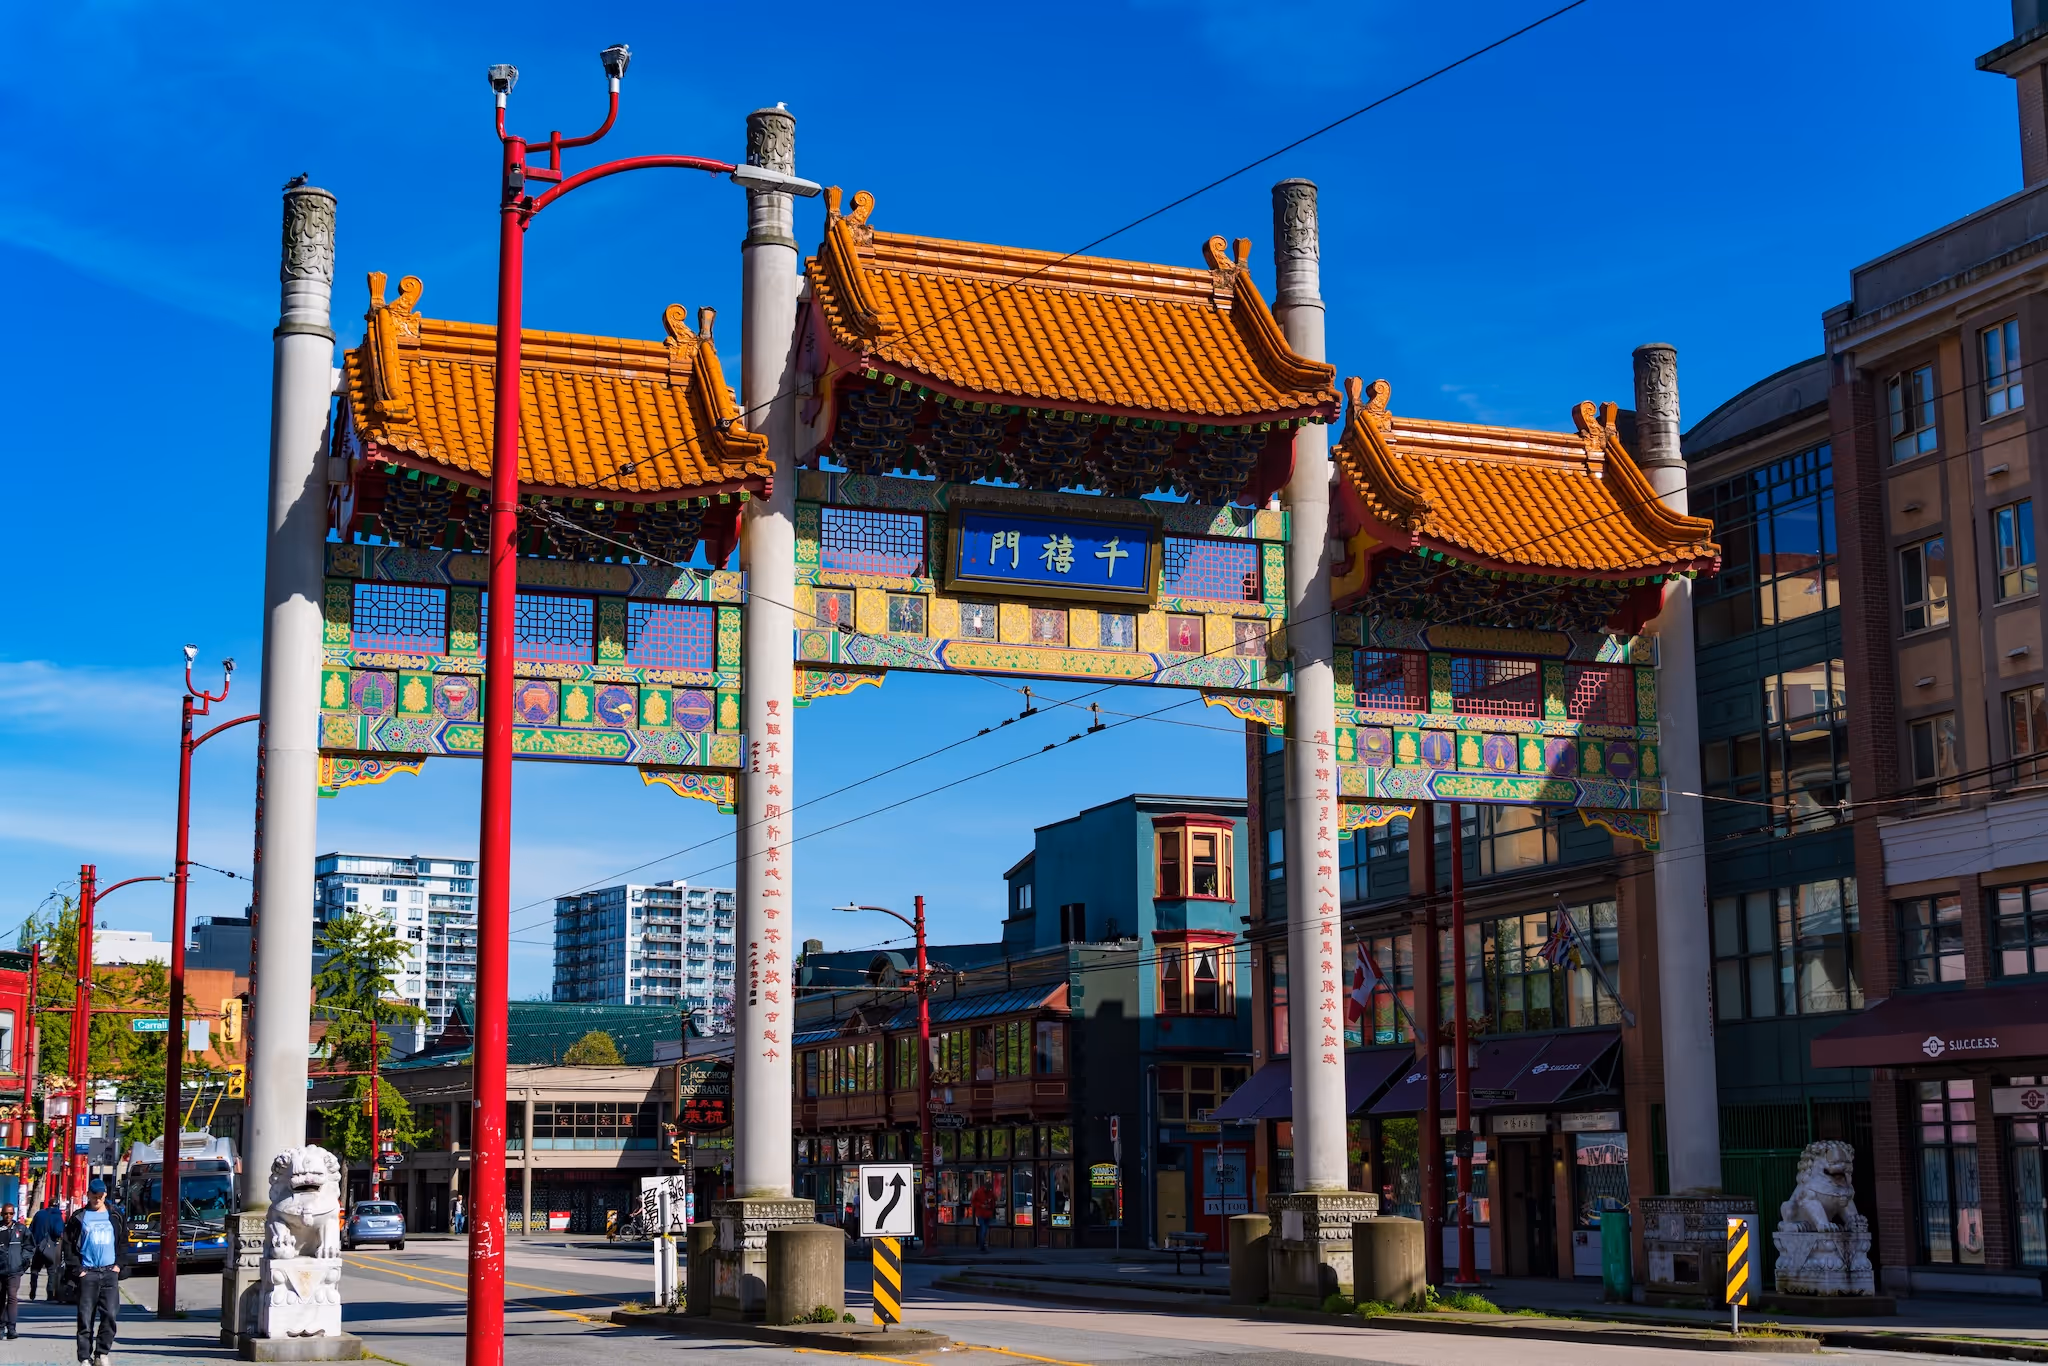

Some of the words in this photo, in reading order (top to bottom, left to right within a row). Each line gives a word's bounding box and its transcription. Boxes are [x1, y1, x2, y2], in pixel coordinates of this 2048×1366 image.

[989, 530, 1129, 579] 千禧門
[137, 1021, 167, 1029] Carrall
[1949, 1037, 2000, 1051] S.U.C.C.E.S.S.
[690, 1071, 707, 1079] JACK
[707, 1071, 729, 1080] CHOW
[681, 1084, 730, 1095] INSURANCE
[80, 1116, 87, 1125] T
